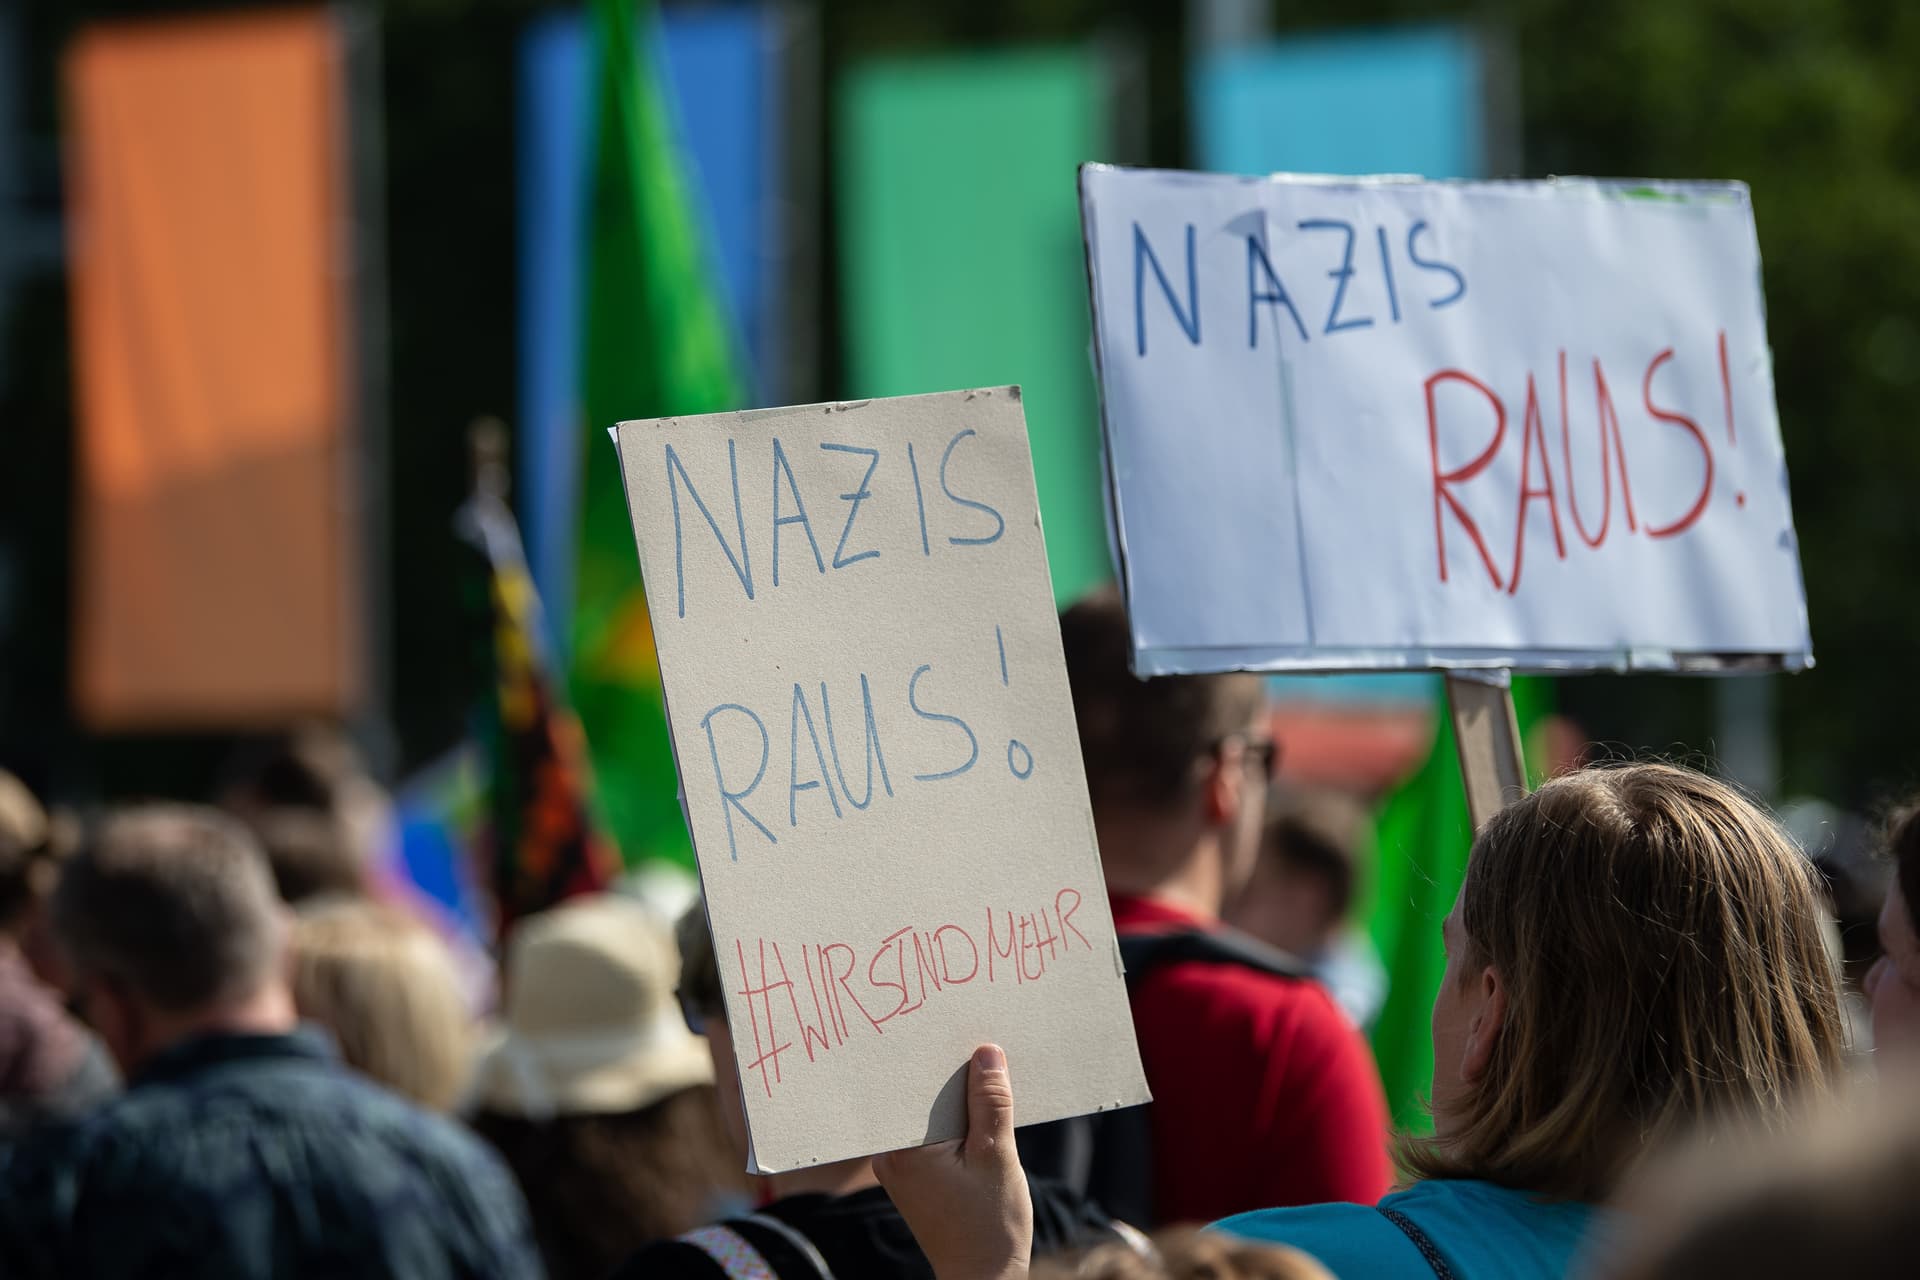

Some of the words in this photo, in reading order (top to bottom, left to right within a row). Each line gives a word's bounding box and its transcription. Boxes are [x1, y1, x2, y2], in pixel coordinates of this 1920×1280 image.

[1132, 219, 1466, 358] NAZIS
[665, 429, 1004, 618] NAZIS
[1423, 330, 1747, 596] RAUS!
[701, 624, 1033, 862] RAUS!
